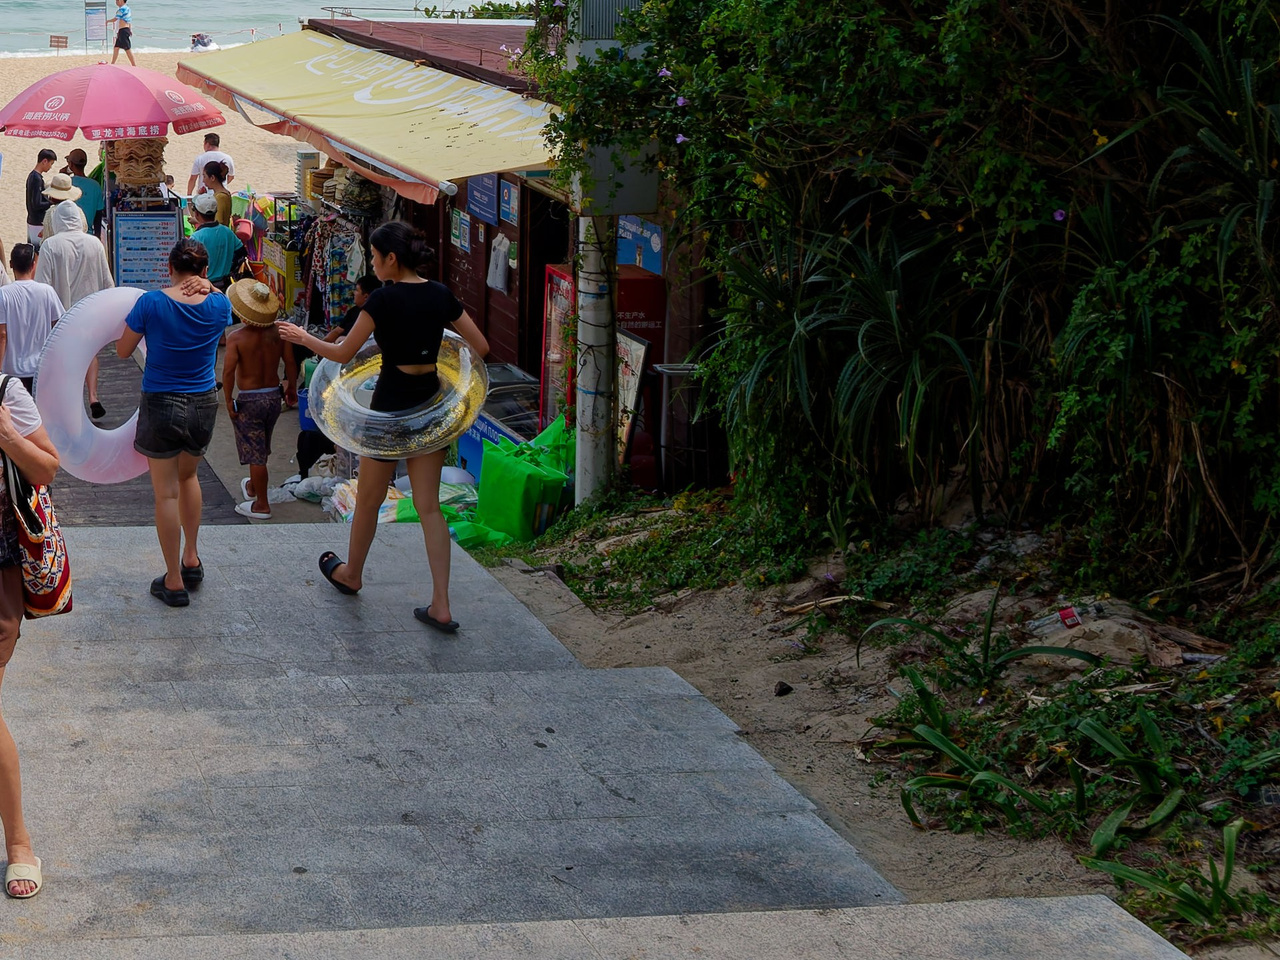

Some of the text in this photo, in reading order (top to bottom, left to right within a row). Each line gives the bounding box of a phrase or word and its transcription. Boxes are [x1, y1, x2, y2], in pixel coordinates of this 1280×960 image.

[22, 111, 71, 121] 海底捞火锅
[91, 125, 160, 139] 亚龙湾海底捞
